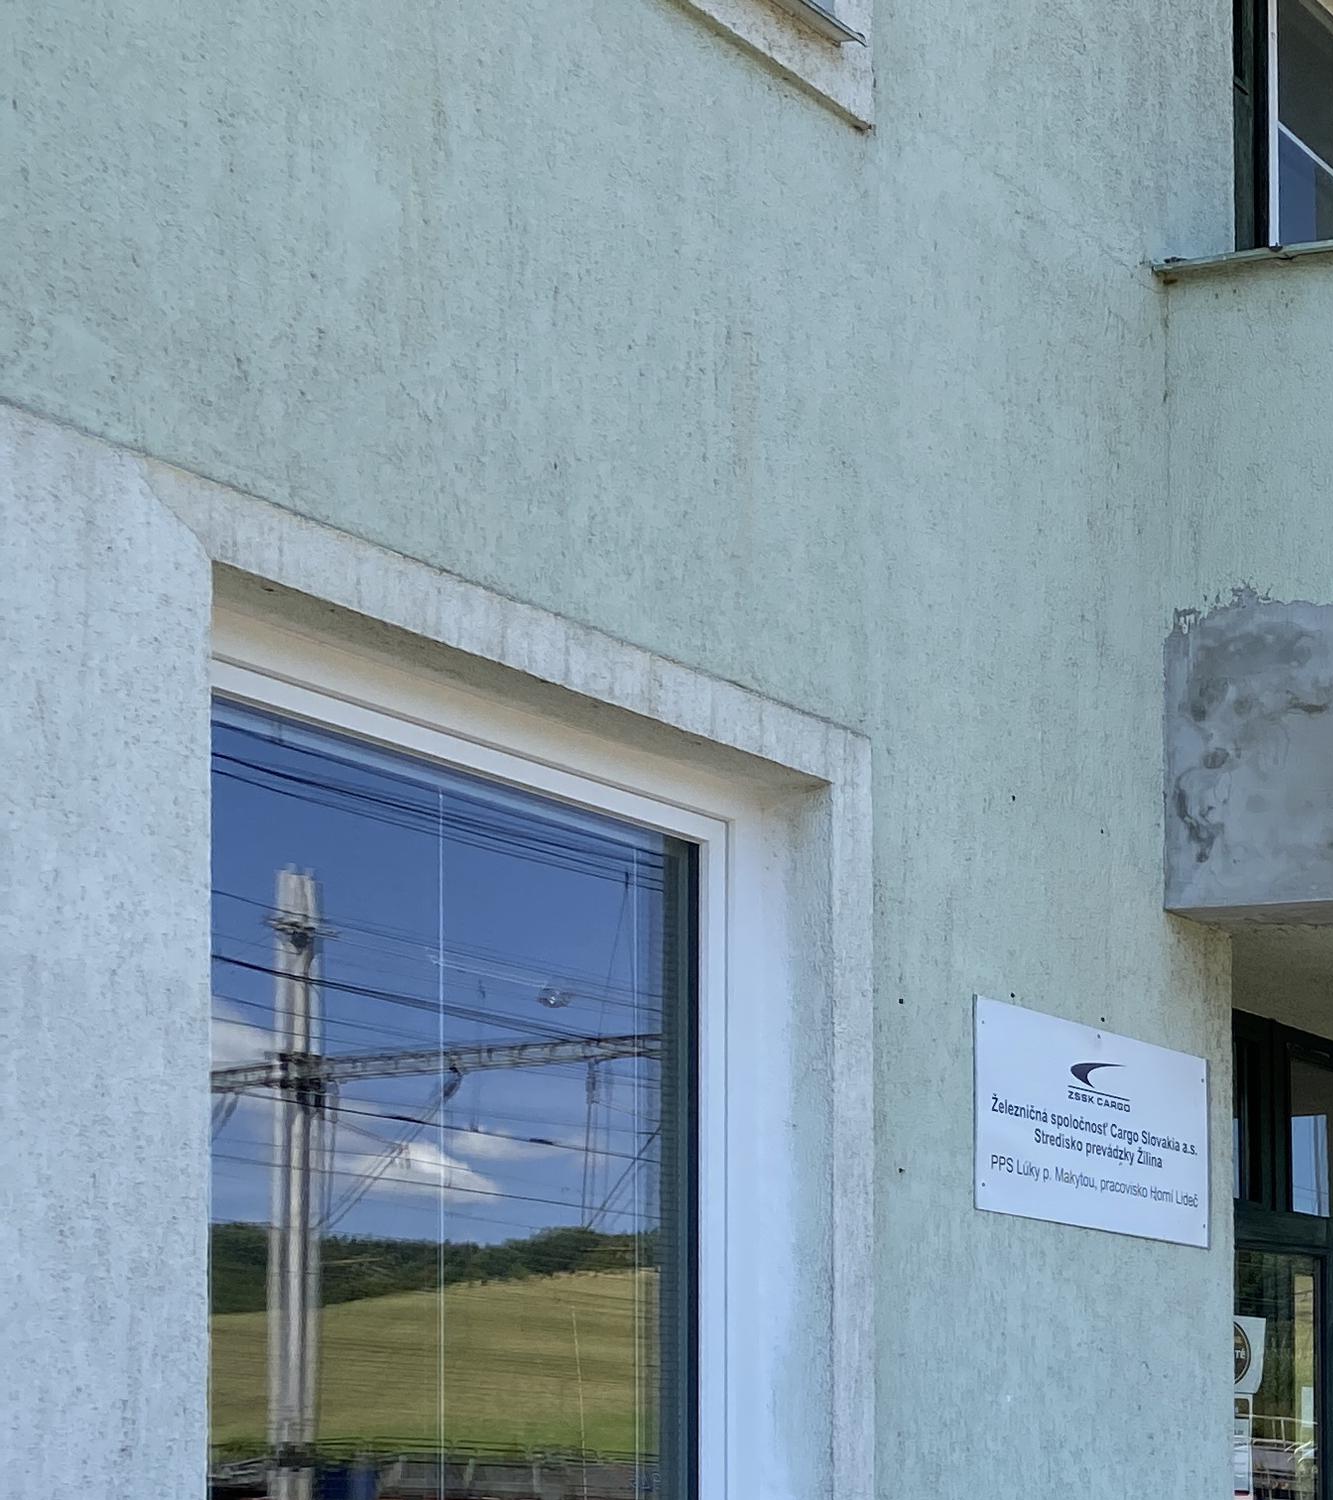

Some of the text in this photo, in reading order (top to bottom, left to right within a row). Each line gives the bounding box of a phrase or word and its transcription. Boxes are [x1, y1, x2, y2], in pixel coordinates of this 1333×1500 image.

[1068, 1090, 1130, 1112] ZSSK CARGO
[991, 1093, 1198, 1155] Železničná spoločnosť Cargo Slovakia a.s.
[1034, 1128, 1163, 1168] Stredisko prevádzky Žilina
[991, 1154, 1014, 1173] PPS
[1017, 1159, 1040, 1181] Lúky
[1043, 1168, 1052, 1182] p.
[1055, 1166, 1098, 1190] Makytou,
[1100, 1179, 1148, 1198] pracovisko
